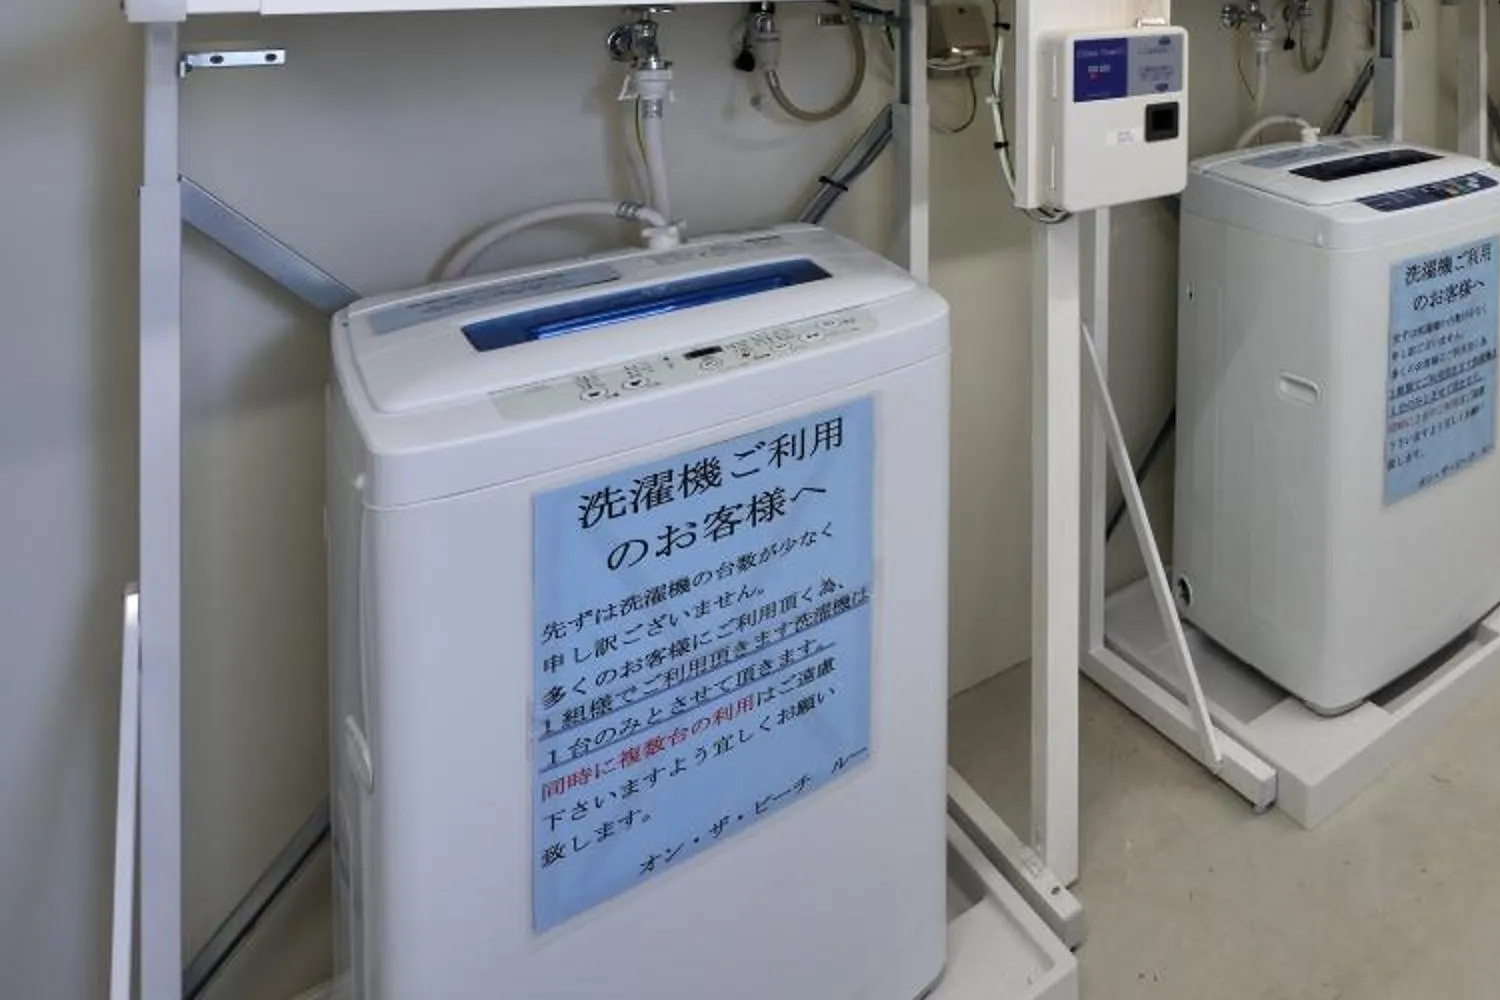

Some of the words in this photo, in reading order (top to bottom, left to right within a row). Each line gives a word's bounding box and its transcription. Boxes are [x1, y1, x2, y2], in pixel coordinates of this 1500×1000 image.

[578, 416, 844, 529] 洗濯機ご利用
[606, 484, 826, 571] のお客様へ
[541, 520, 833, 644] 先ずは洗濯機の台数が少なく
[542, 584, 766, 675] 申し訳ございません。
[542, 576, 845, 708] 多くのお客様にご利用頂く為、
[541, 655, 836, 801] 同時に複数台の利用はご遠慮
[544, 684, 836, 832] 下さいますよう宜しくお願い
[541, 808, 652, 868] 致します。
